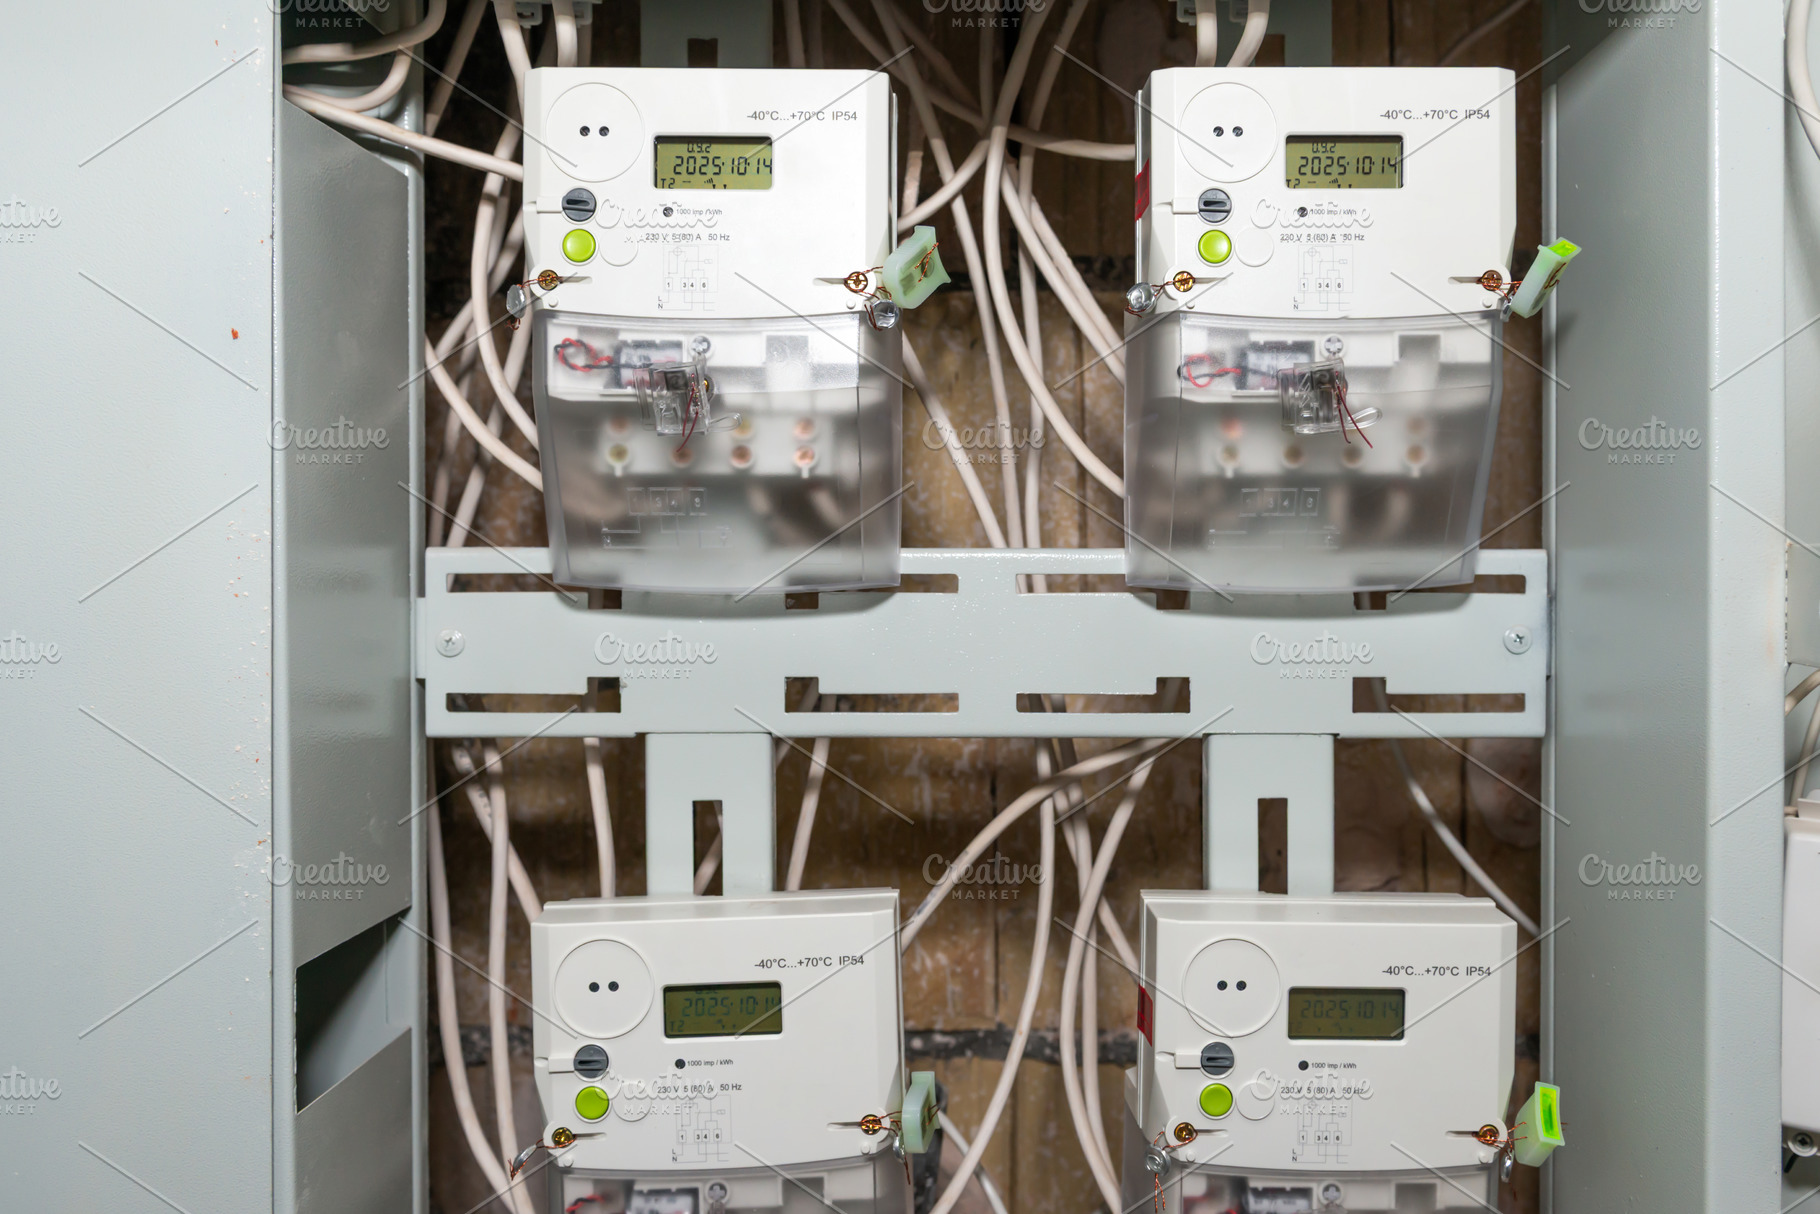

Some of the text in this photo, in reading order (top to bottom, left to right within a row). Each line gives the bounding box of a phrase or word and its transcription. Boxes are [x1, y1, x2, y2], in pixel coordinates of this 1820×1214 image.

[832, 110, 858, 121] IP54
[1465, 109, 1490, 119] IP54
[645, 233, 659, 241] 230
[695, 233, 702, 241] A
[708, 233, 717, 241] 50
[720, 233, 730, 241] Hz
[1343, 233, 1352, 241] 50
[1354, 233, 1365, 241] Hz
[839, 955, 864, 966] IP54
[1466, 966, 1491, 976] IP54
[657, 1086, 671, 1094] 230
[1313, 1086, 1328, 1095] (80)
